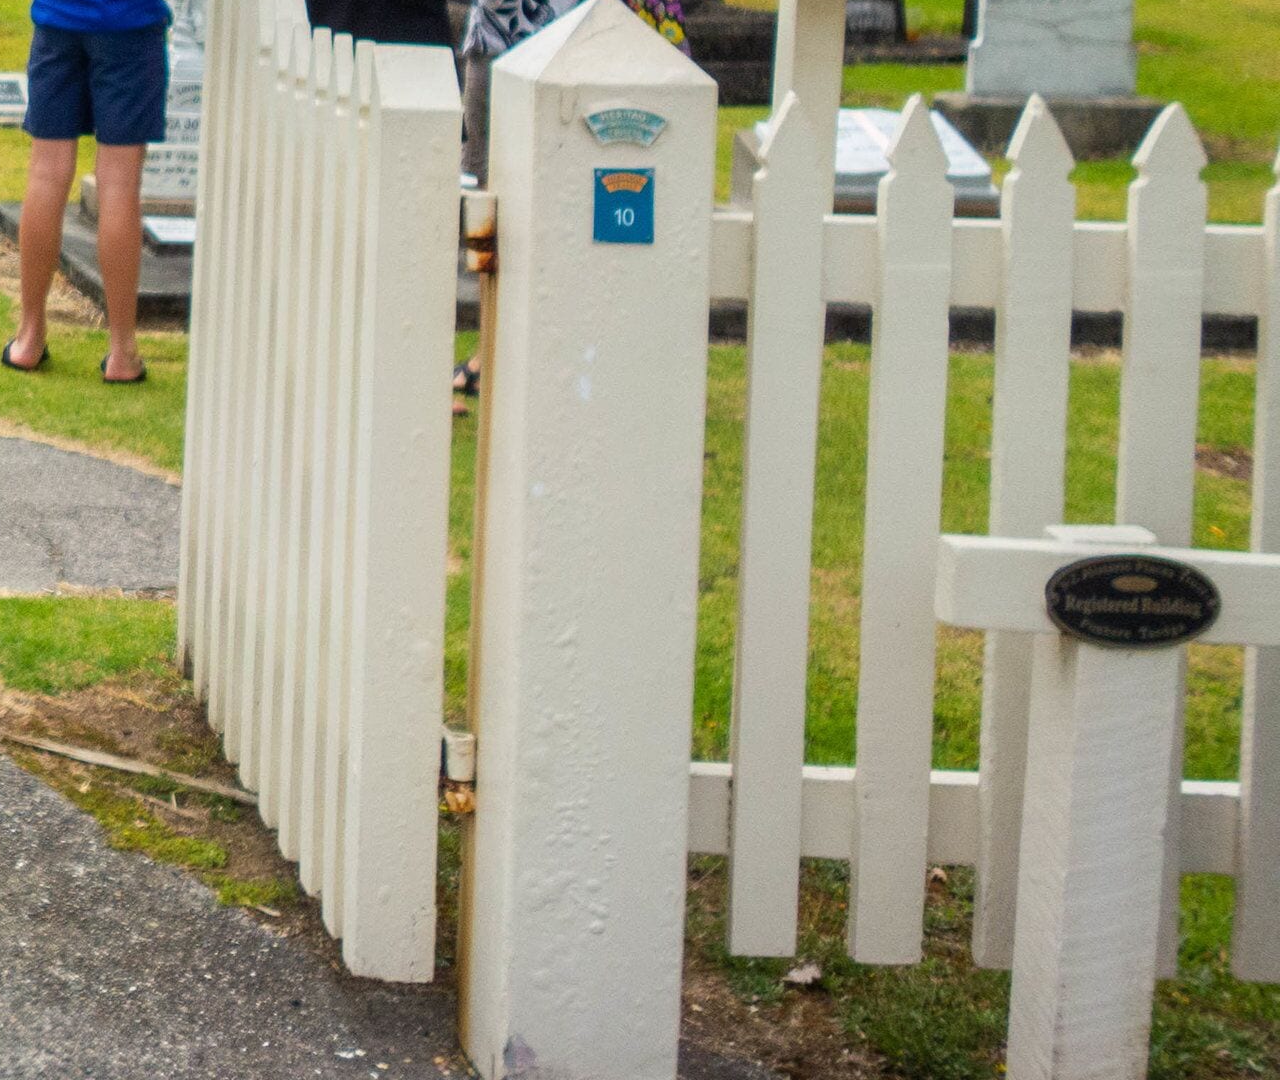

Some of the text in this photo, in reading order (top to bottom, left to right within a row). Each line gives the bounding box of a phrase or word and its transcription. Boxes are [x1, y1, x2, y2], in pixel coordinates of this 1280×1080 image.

[614, 207, 635, 227] 10
[1064, 594, 1203, 619] Registered Building
